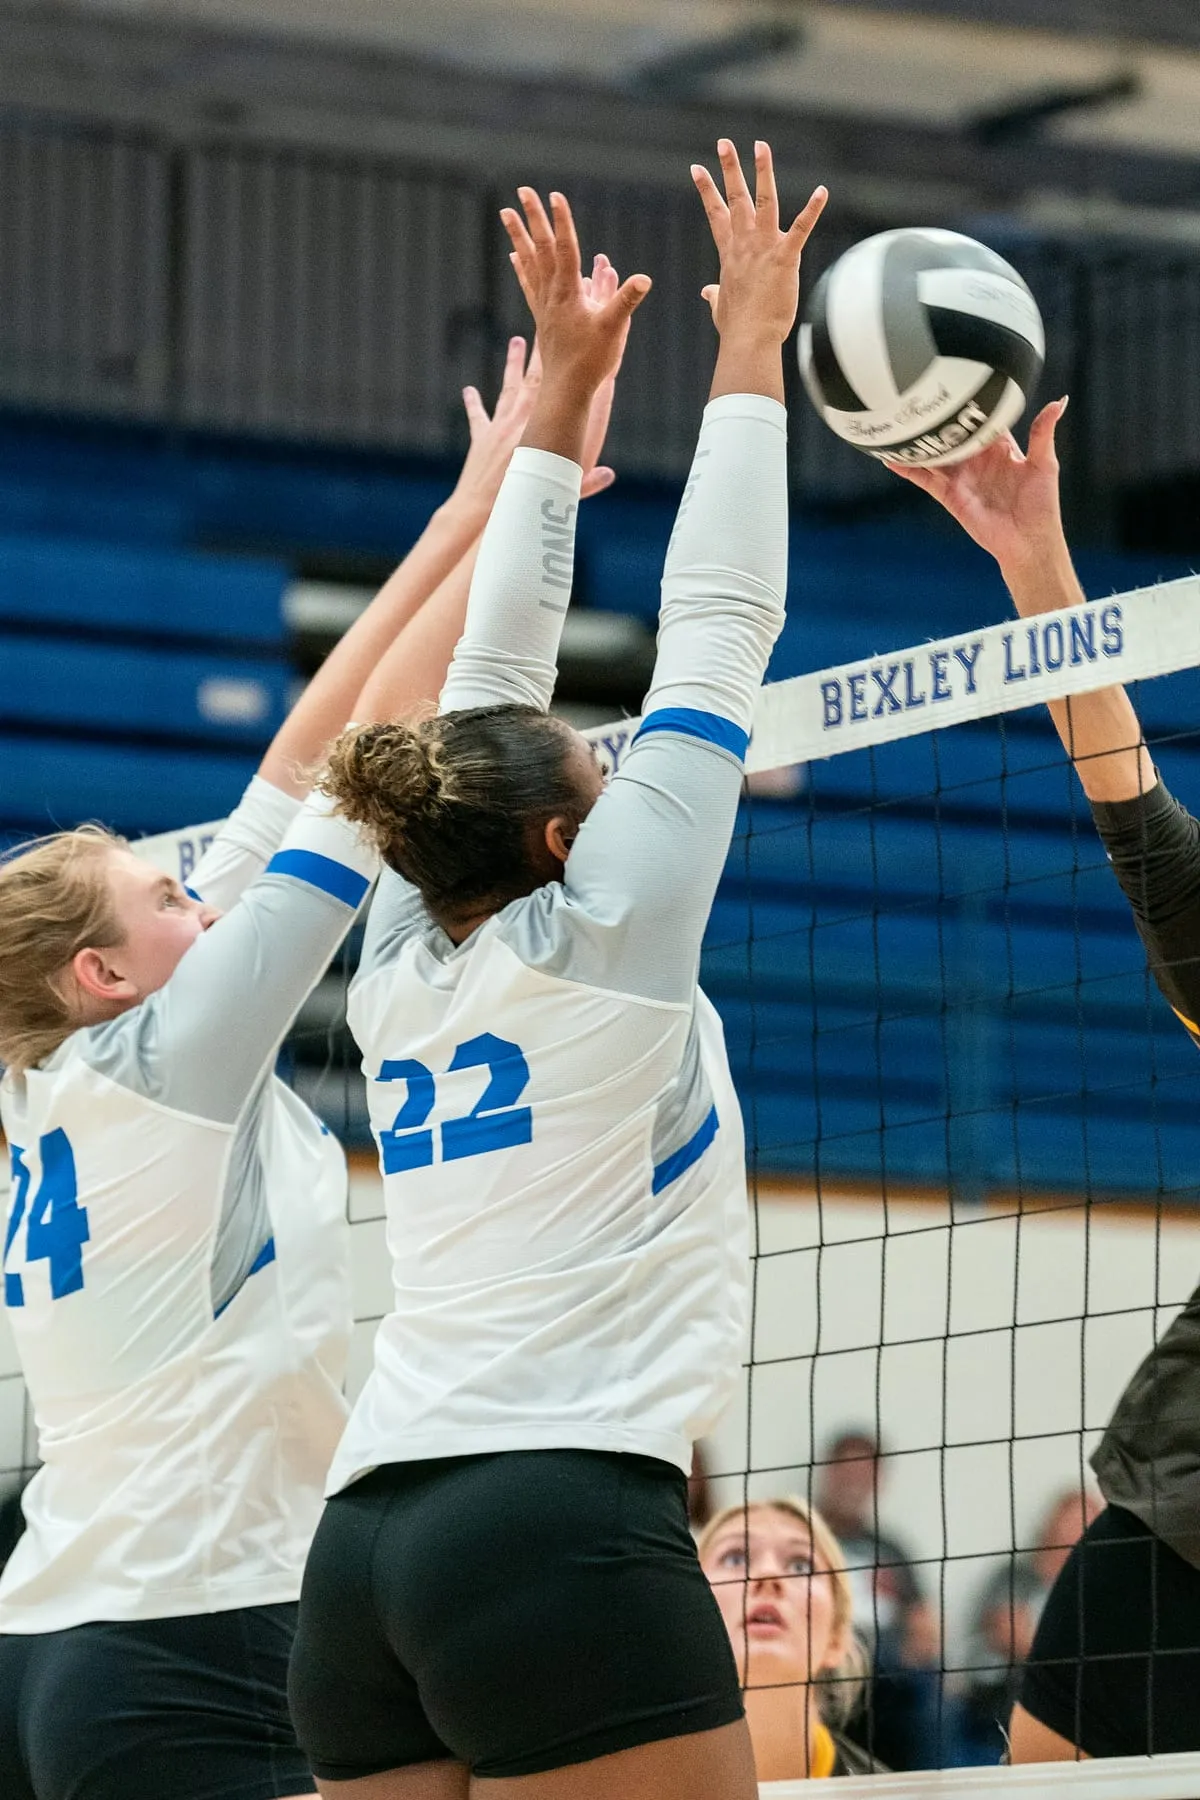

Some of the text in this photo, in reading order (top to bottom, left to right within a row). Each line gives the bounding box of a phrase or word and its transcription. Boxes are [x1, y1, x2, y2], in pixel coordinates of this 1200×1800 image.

[820, 602, 1125, 731] BEXLEY LIONS
[374, 1031, 533, 1176] 22
